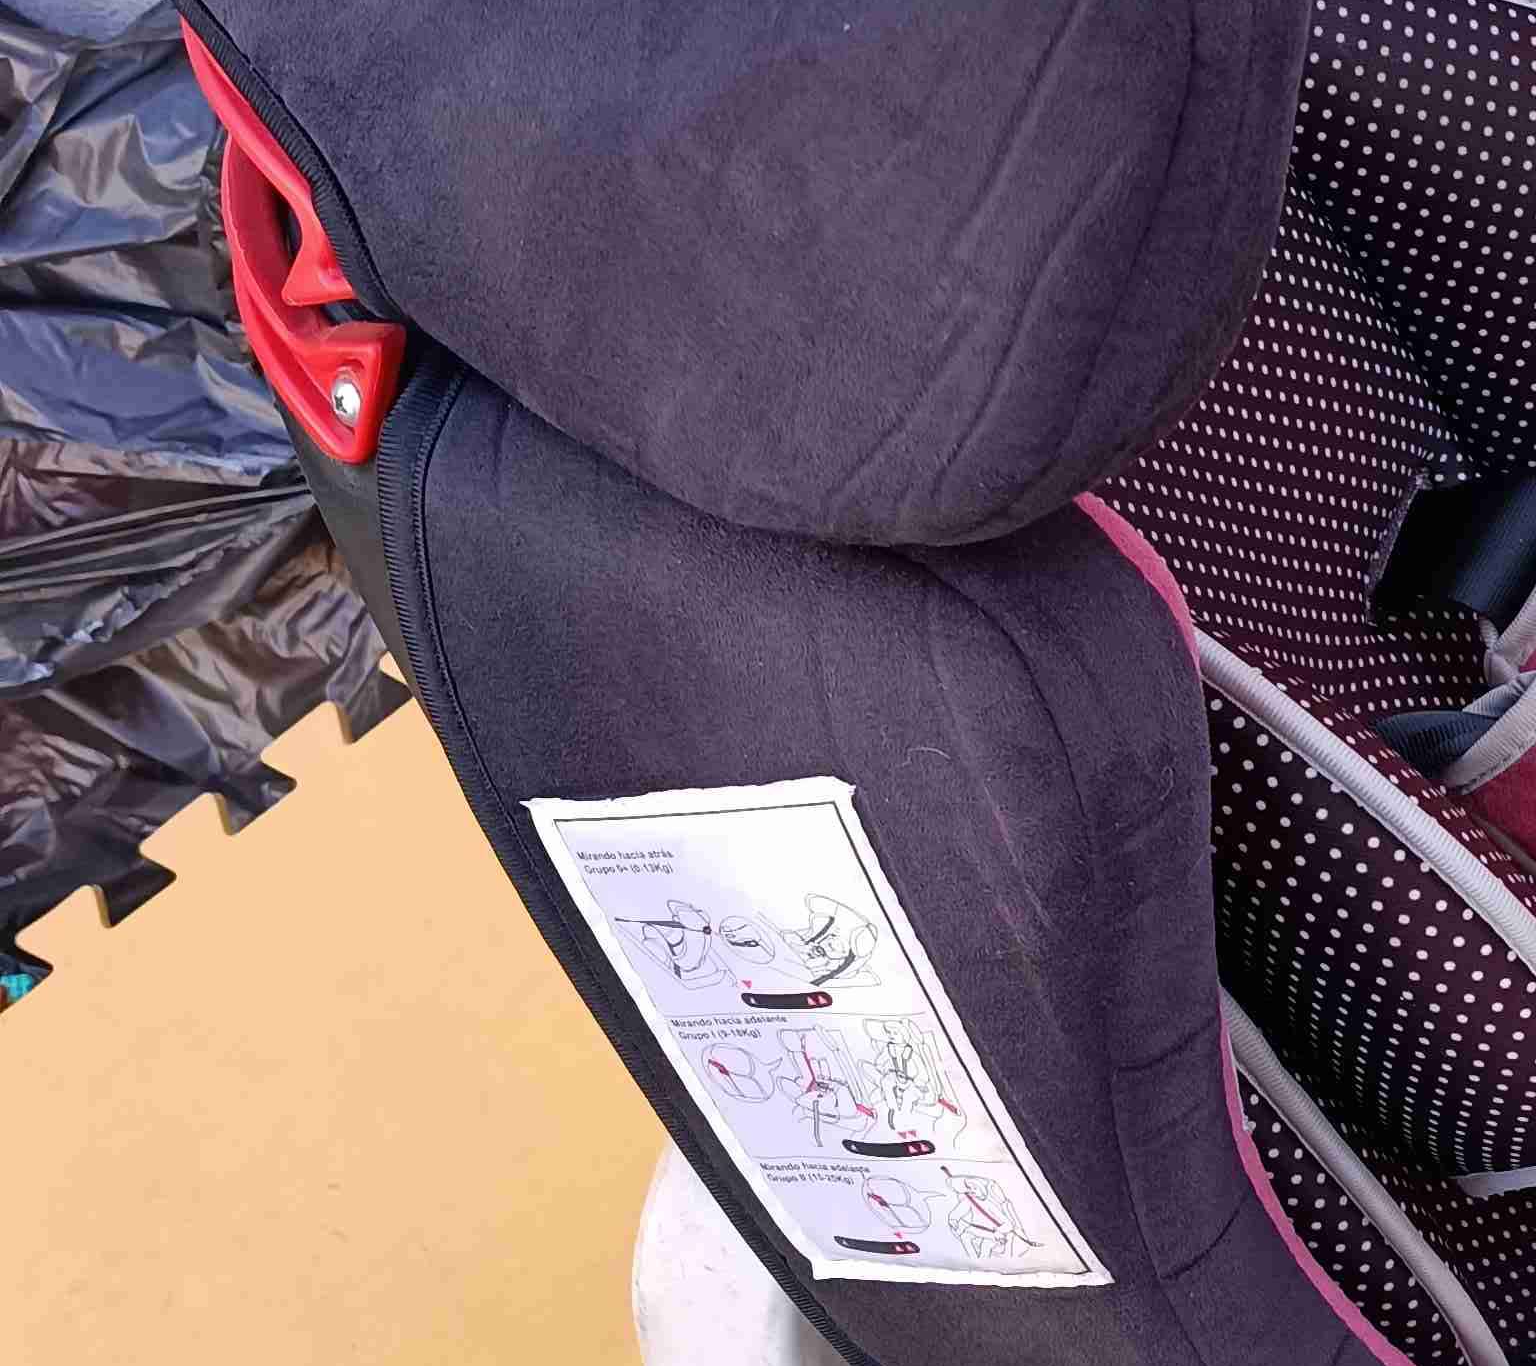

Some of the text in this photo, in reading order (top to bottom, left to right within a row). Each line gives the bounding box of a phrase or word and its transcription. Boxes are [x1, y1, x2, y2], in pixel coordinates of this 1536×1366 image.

[576, 850, 617, 860] Mirando
[617, 850, 646, 860] hacia
[584, 864, 616, 875] Grupo
[670, 1015, 788, 1027] Mirando hacia adelante
[678, 1030, 710, 1040] Grupo
[760, 1161, 871, 1173] Mirando hacia adelante
[767, 1173, 799, 1183] Grupo
